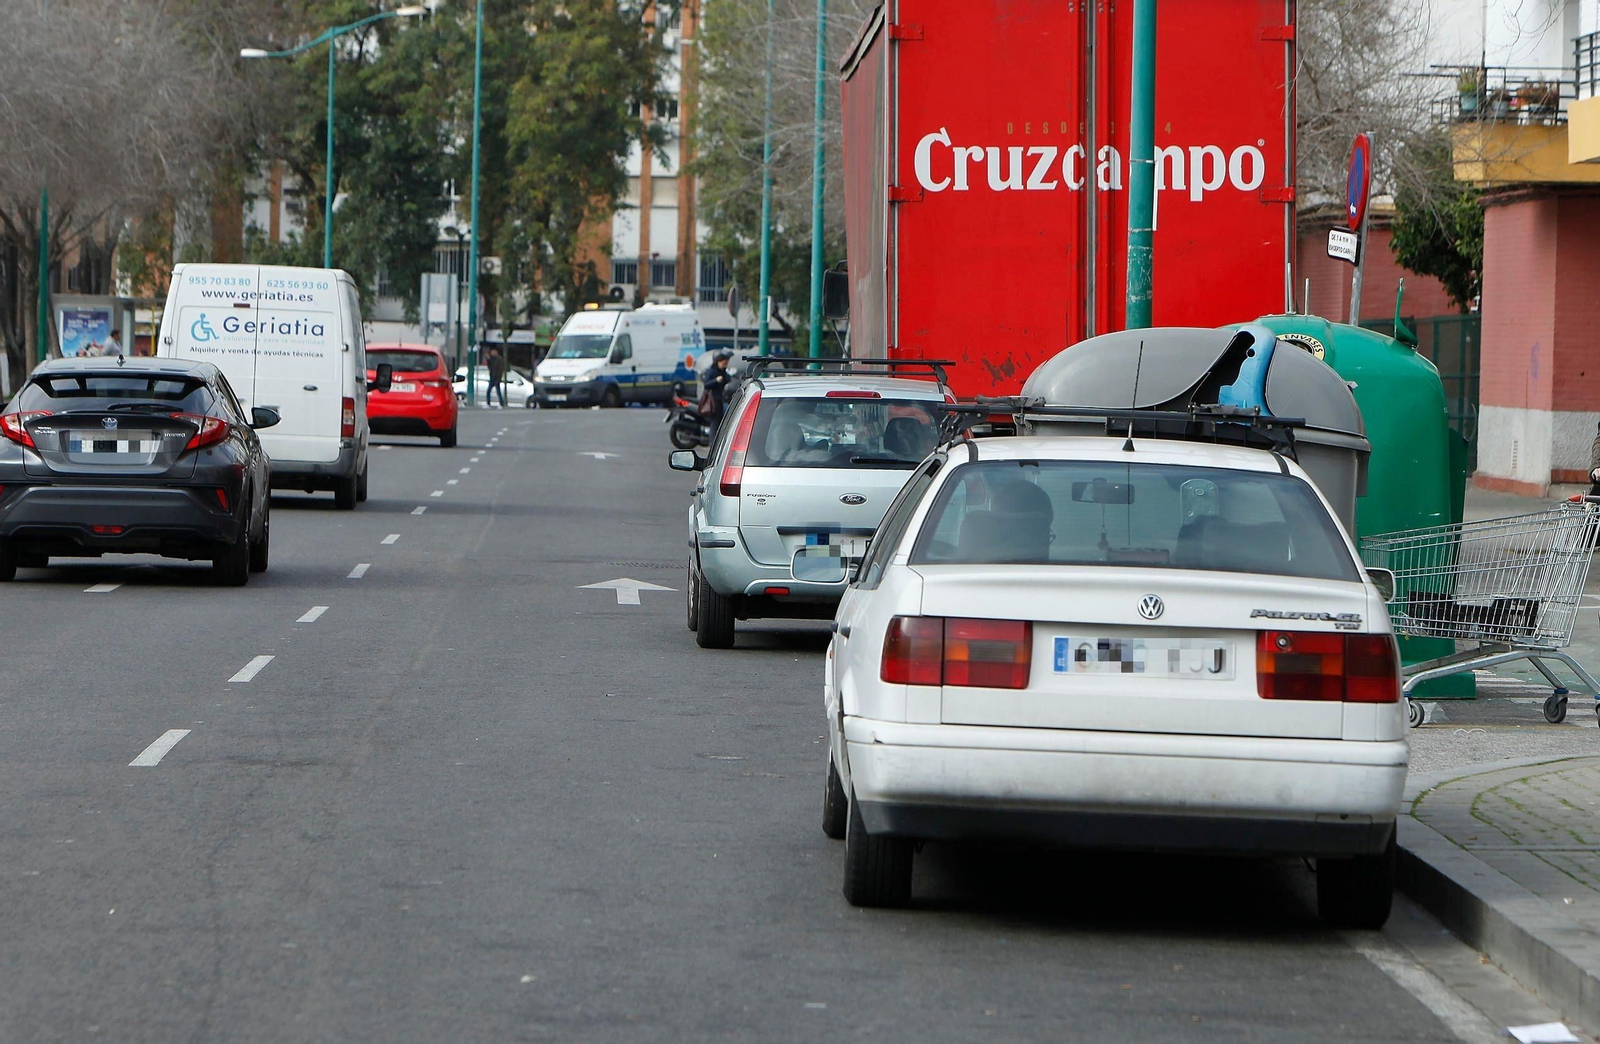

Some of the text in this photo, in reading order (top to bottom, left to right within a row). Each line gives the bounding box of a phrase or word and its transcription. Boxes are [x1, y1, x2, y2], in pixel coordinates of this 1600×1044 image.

[1007, 122, 1085, 135] DESDE
[914, 127, 1265, 202] Cruzcampo
[188, 276, 251, 287] 955 70 83 80
[266, 279, 329, 290] 625 56 93 60
[201, 289, 313, 302] www.geriatia.es
[223, 316, 324, 337] Geriatia
[1284, 334, 1323, 352] ENVASES
[190, 346, 219, 354] Alquiler
[292, 350, 324, 358] técnicas
[1250, 608, 1332, 621] Passat
